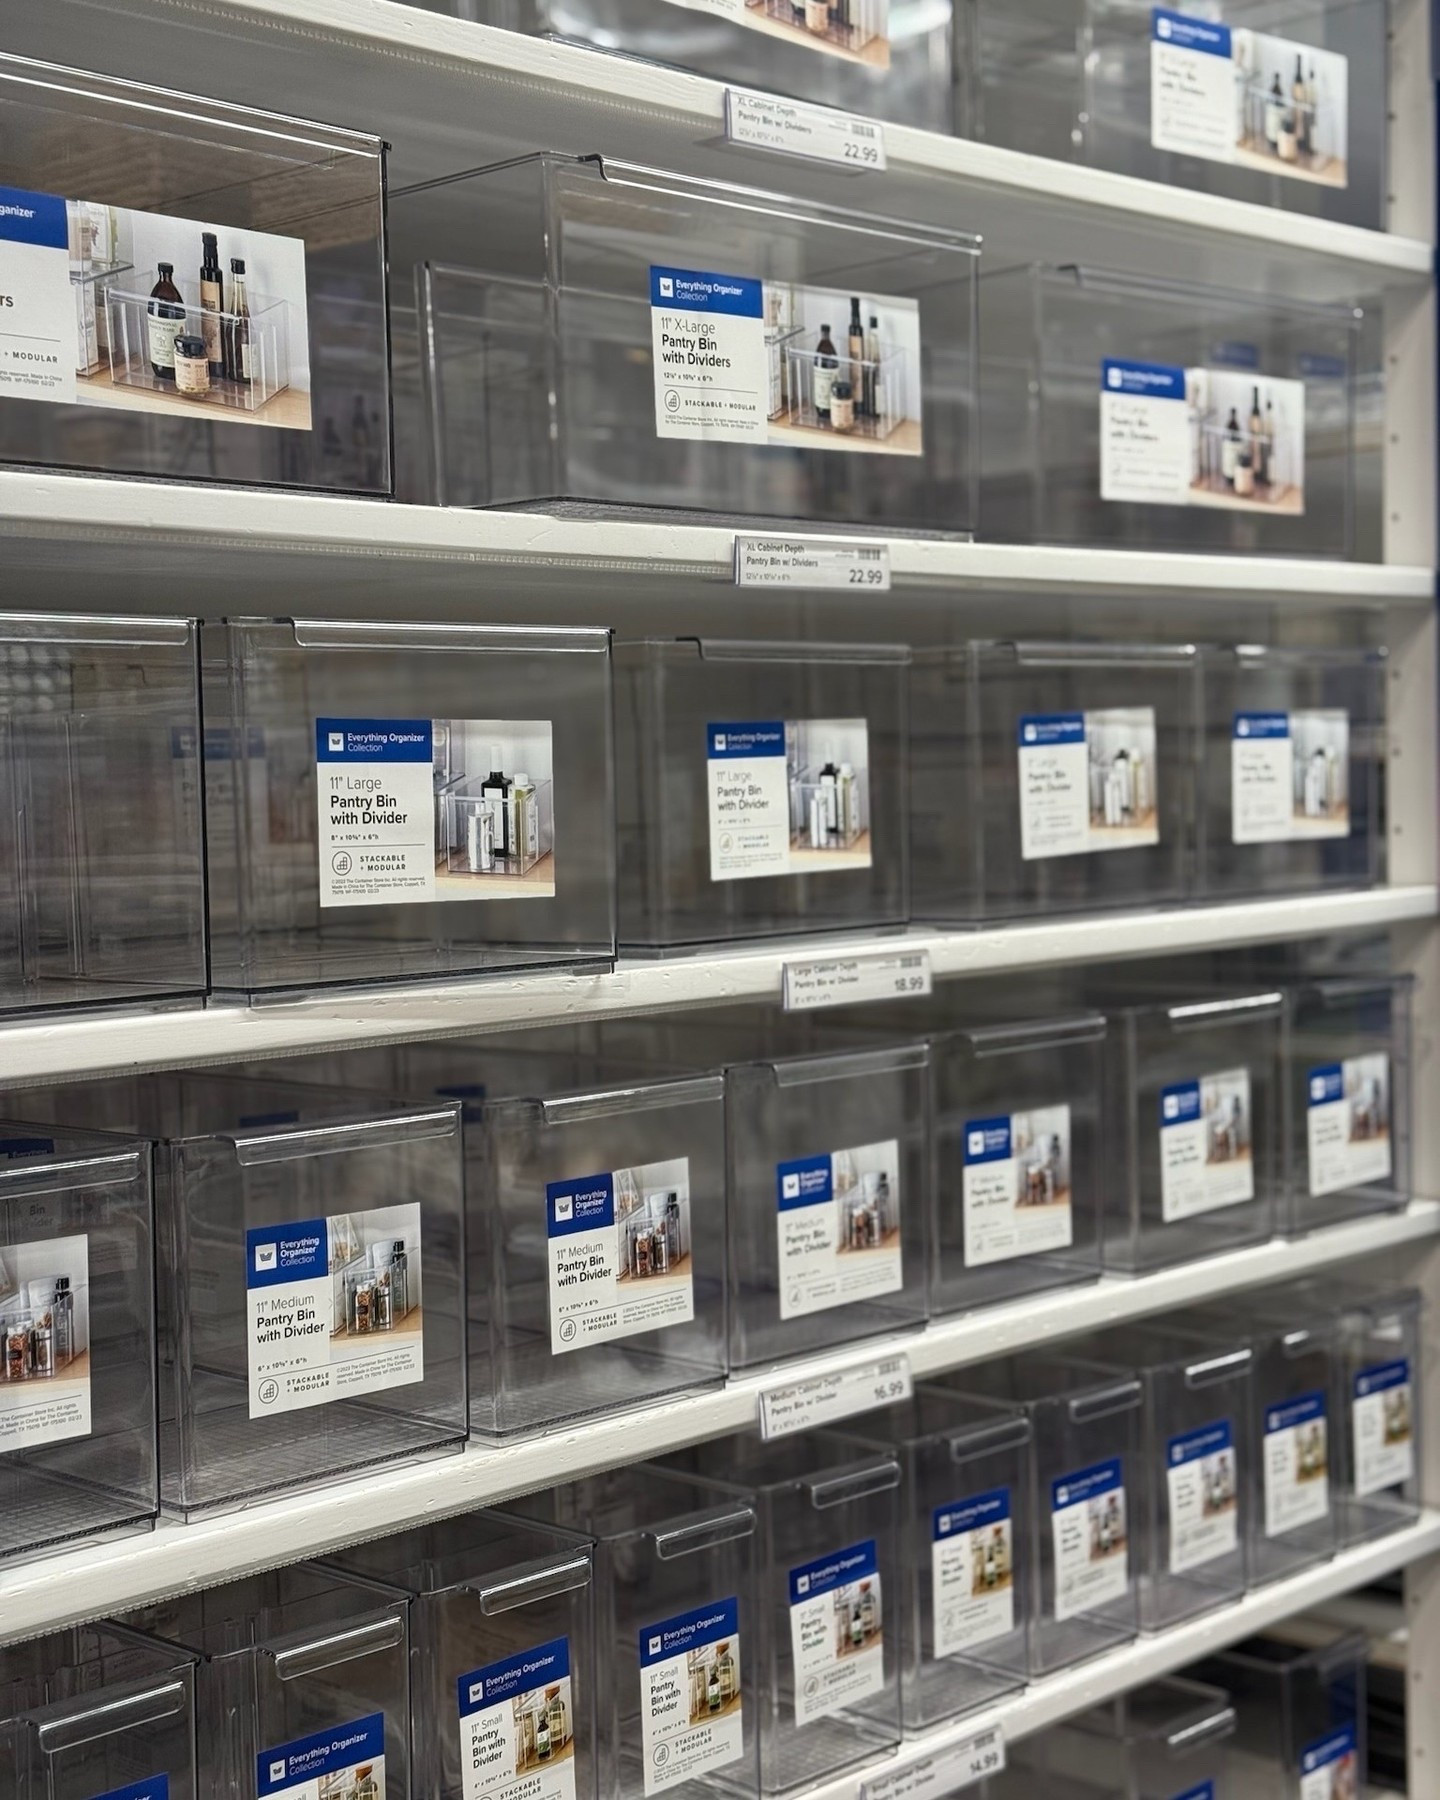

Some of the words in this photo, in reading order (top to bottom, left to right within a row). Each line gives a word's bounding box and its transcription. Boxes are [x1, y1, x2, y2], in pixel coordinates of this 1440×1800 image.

[737, 96, 747, 106] XL
[749, 99, 774, 112] Cabinet
[777, 105, 797, 117] Depth
[738, 110, 760, 125] Pantry
[762, 115, 773, 125] Bin
[784, 121, 812, 134] Dividers
[844, 143, 878, 163] 22.99
[0, 205, 35, 218] ganizer
[676, 279, 712, 293] Everything
[713, 283, 743, 295] Organizer
[676, 290, 708, 301] Collection
[675, 318, 715, 336] X-Large
[662, 334, 695, 351] Pantry
[699, 337, 717, 350] Bin
[13, 351, 58, 363] MODULAR
[662, 351, 685, 364] with
[688, 352, 731, 368] Dividers
[685, 400, 722, 408] STACKABLE
[729, 403, 756, 411] MODULAR
[746, 542, 756, 551] XL
[757, 543, 783, 552] Cabinet
[785, 544, 805, 554] Depth
[746, 556, 768, 567] Pantry
[769, 557, 781, 566] Bin
[782, 558, 790, 566] w/
[792, 559, 818, 568] Dividers
[850, 569, 883, 584] 22.99
[347, 732, 388, 744] Everything
[389, 733, 425, 744] Organizer
[727, 733, 756, 743] Everything
[756, 732, 781, 742] Organizer
[347, 743, 383, 752] Collection
[330, 776, 343, 790] 11"
[347, 776, 382, 792] Large
[728, 770, 752, 783] Large
[717, 786, 746, 799] Pantry
[748, 784, 762, 795] Bin
[331, 795, 373, 811] Pantry
[376, 794, 397, 807] Bin
[718, 800, 736, 811] with
[739, 798, 769, 810] Divider
[330, 811, 358, 825] with
[362, 811, 408, 824] Divider
[360, 855, 406, 863] STACKABLE
[895, 976, 924, 991] 18.99
[575, 1190, 607, 1203] Everything
[575, 1199, 605, 1210] Organizer
[575, 1207, 604, 1219] Collection
[280, 1237, 320, 1251] Everything
[568, 1241, 604, 1257] Medium
[280, 1246, 317, 1259] Organizer
[280, 1255, 315, 1267] Collection
[557, 1259, 588, 1274] Pantry
[589, 1255, 605, 1267] Bin
[557, 1274, 578, 1288] with
[579, 1267, 612, 1283] Divider
[256, 1300, 269, 1314] 11"
[271, 1294, 315, 1311] Medium
[257, 1312, 294, 1329] Pantry
[297, 1309, 315, 1322] Bin
[582, 1312, 618, 1326] STACKABLE
[588, 1319, 618, 1333] MODULAR
[257, 1330, 281, 1344] with
[284, 1322, 325, 1338] Divider
[286, 1372, 330, 1386] STACKABLE
[294, 1380, 330, 1393] MODULAR
[874, 1380, 904, 1401] 16.99
[663, 1624, 696, 1641] Everything
[696, 1613, 725, 1630] Organizer
[801, 1618, 822, 1632] Pantry
[664, 1634, 692, 1651] Collection
[802, 1631, 813, 1642] Bin
[802, 1637, 825, 1652] Divider
[485, 1668, 522, 1688] Everything
[522, 1655, 555, 1674] Organizer
[659, 1666, 679, 1681] Small
[486, 1679, 518, 1698] Collection
[650, 1680, 675, 1695] Pantry
[651, 1693, 664, 1707] Bin
[665, 1688, 682, 1703] with
[651, 1700, 678, 1717] Divider
[481, 1713, 504, 1731] Small
[471, 1728, 499, 1746] Pantry
[675, 1728, 712, 1748] STACKABLE
[289, 1746, 330, 1766] Everything
[331, 1732, 368, 1750] Organizer
[472, 1744, 487, 1758] Bin
[487, 1737, 506, 1753] with
[681, 1736, 712, 1754] MODULAR
[289, 1757, 325, 1776] Collection
[473, 1750, 503, 1769] Divider
[500, 1777, 541, 1800] STACKABLE
